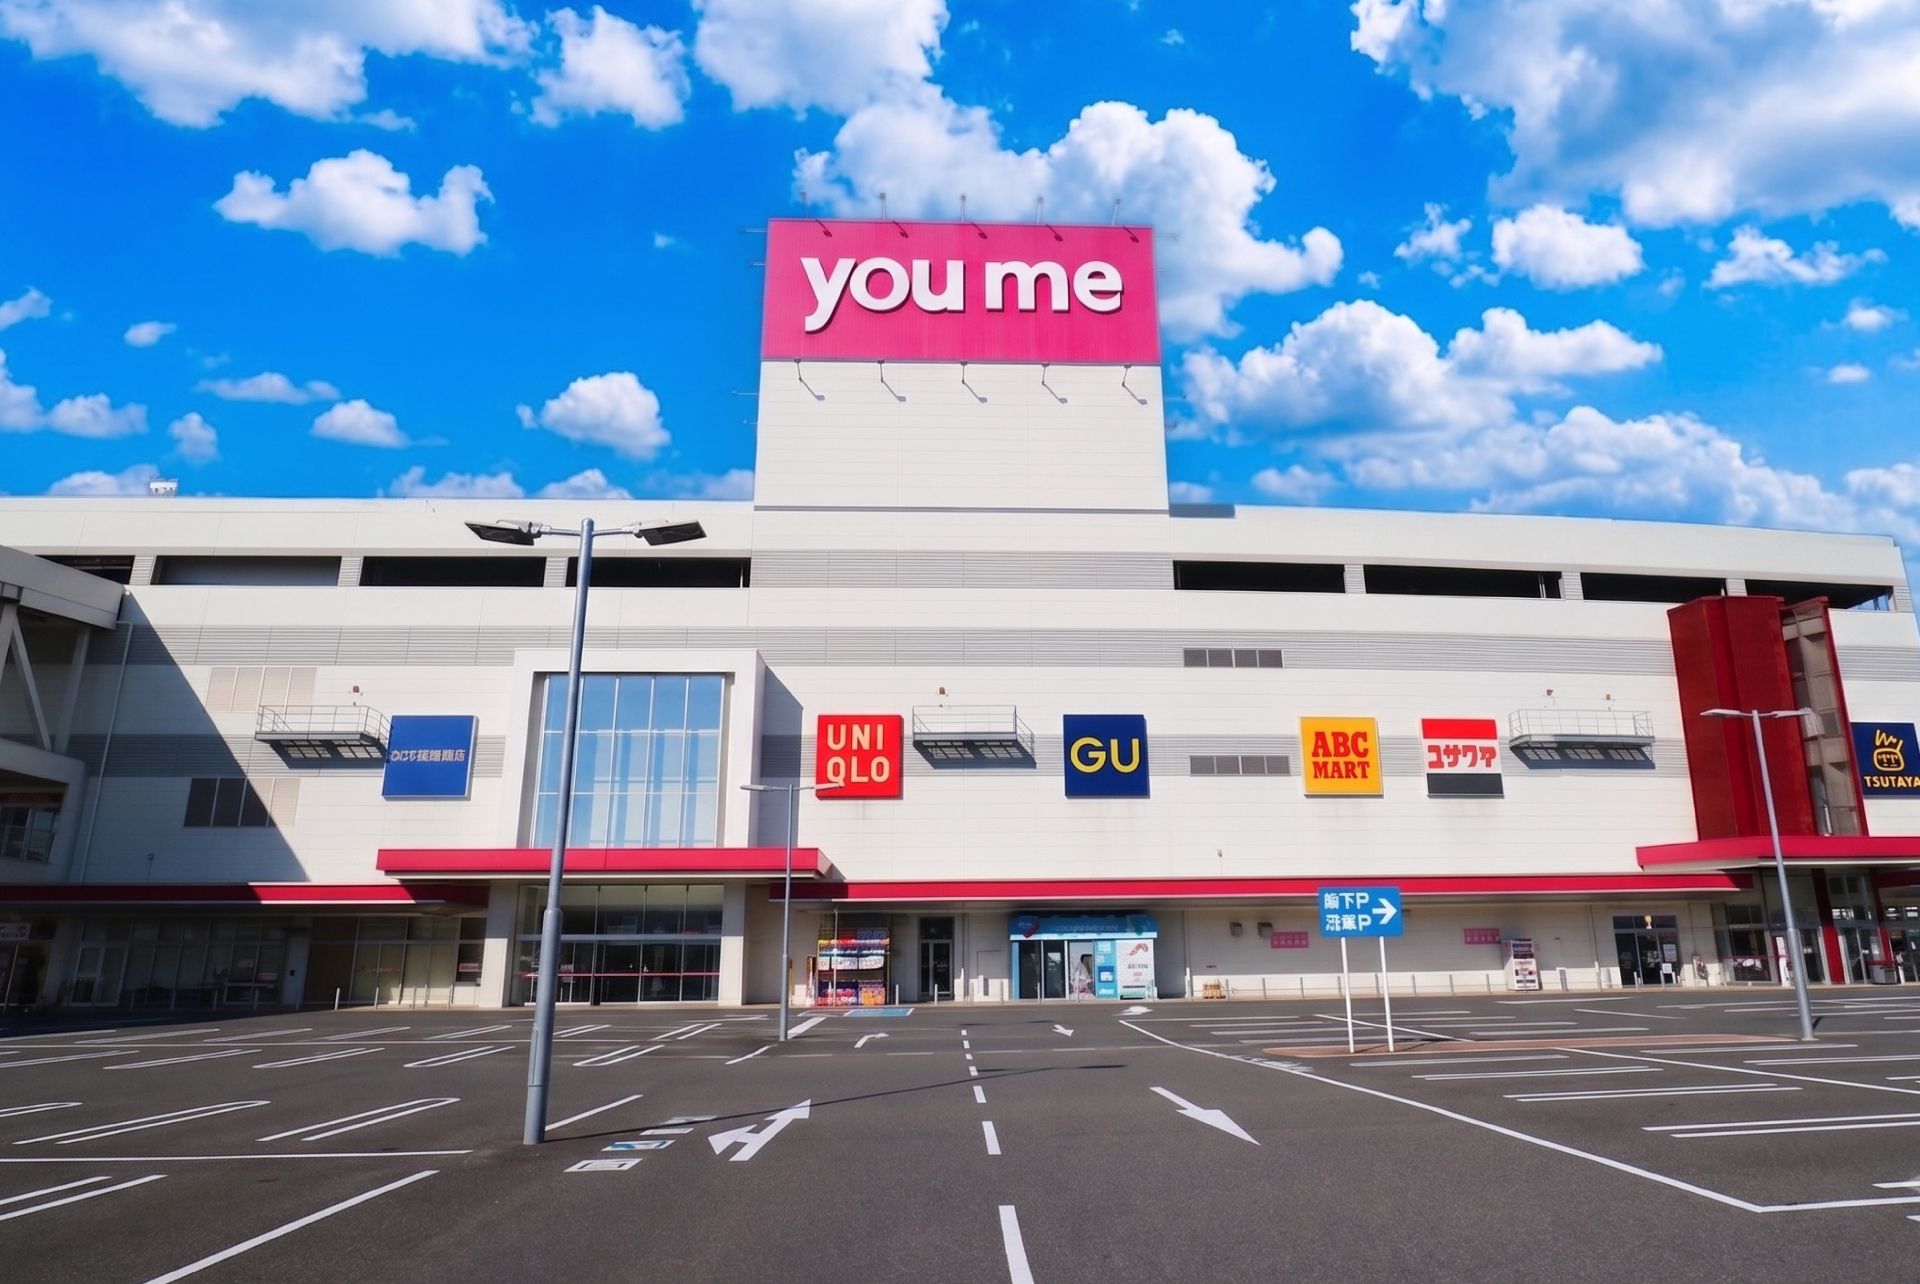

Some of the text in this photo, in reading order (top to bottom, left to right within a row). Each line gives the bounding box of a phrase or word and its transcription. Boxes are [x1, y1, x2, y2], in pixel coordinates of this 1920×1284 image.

[827, 724, 884, 751] UNI
[1311, 731, 1369, 758] ABC
[1069, 736, 1140, 773] GU
[826, 756, 890, 787] QLO
[1312, 761, 1370, 779] MART
[1863, 776, 1920, 788] TSUTAYA
